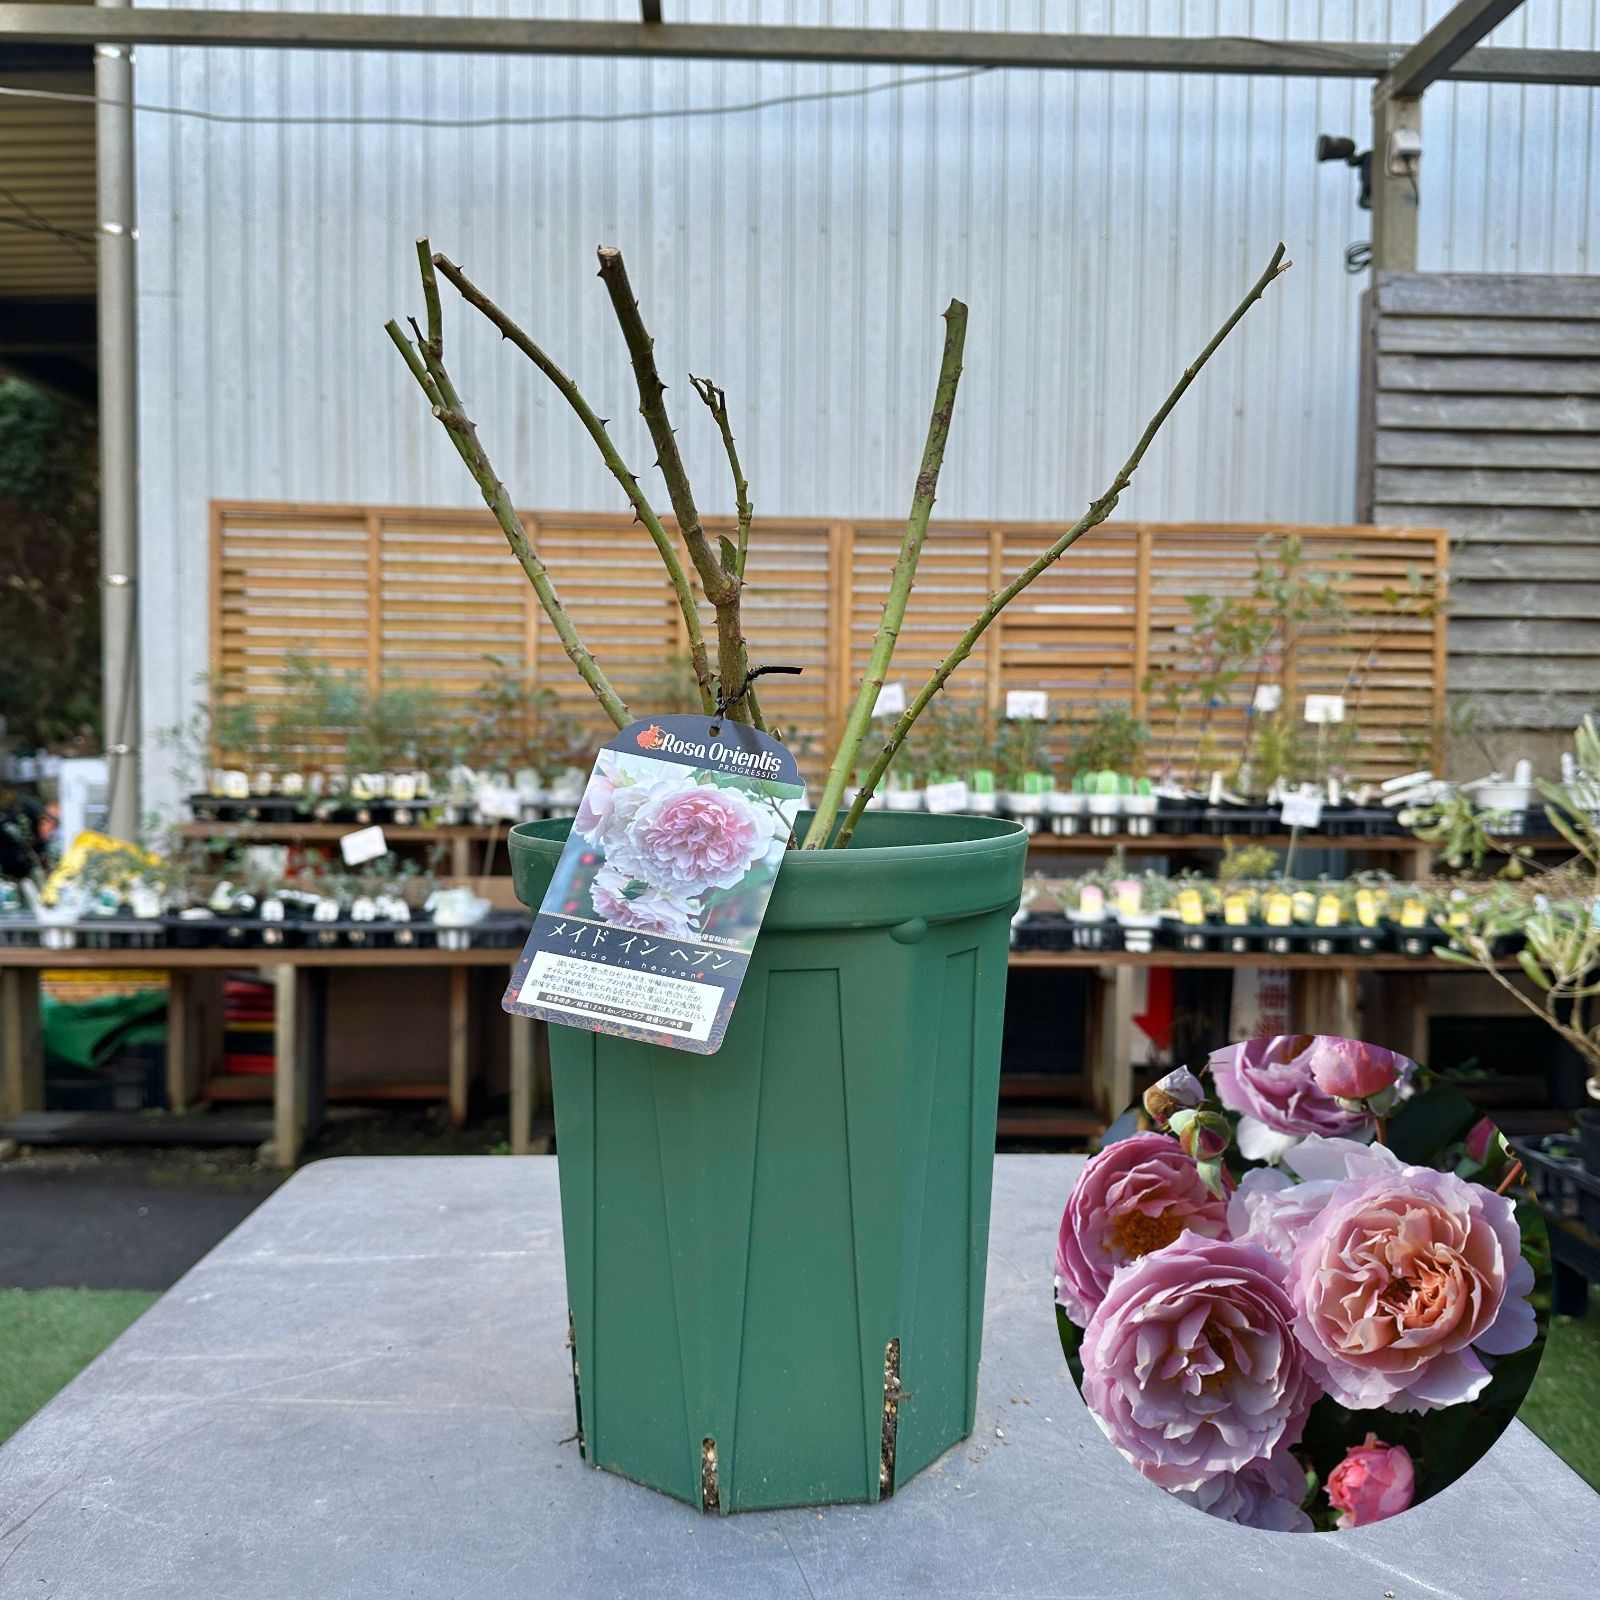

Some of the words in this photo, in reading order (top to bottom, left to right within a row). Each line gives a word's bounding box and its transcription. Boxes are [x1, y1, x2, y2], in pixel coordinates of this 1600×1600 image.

[661, 733, 705, 759] Rosa
[709, 742, 782, 772] Orientis
[718, 763, 778, 780] PROGRESSIO
[547, 922, 610, 947] メイド
[619, 935, 660, 956] イン
[670, 949, 732, 970] ヘブン
[568, 948, 607, 961] Made
[617, 957, 630, 966] in
[641, 961, 696, 979] heaven
